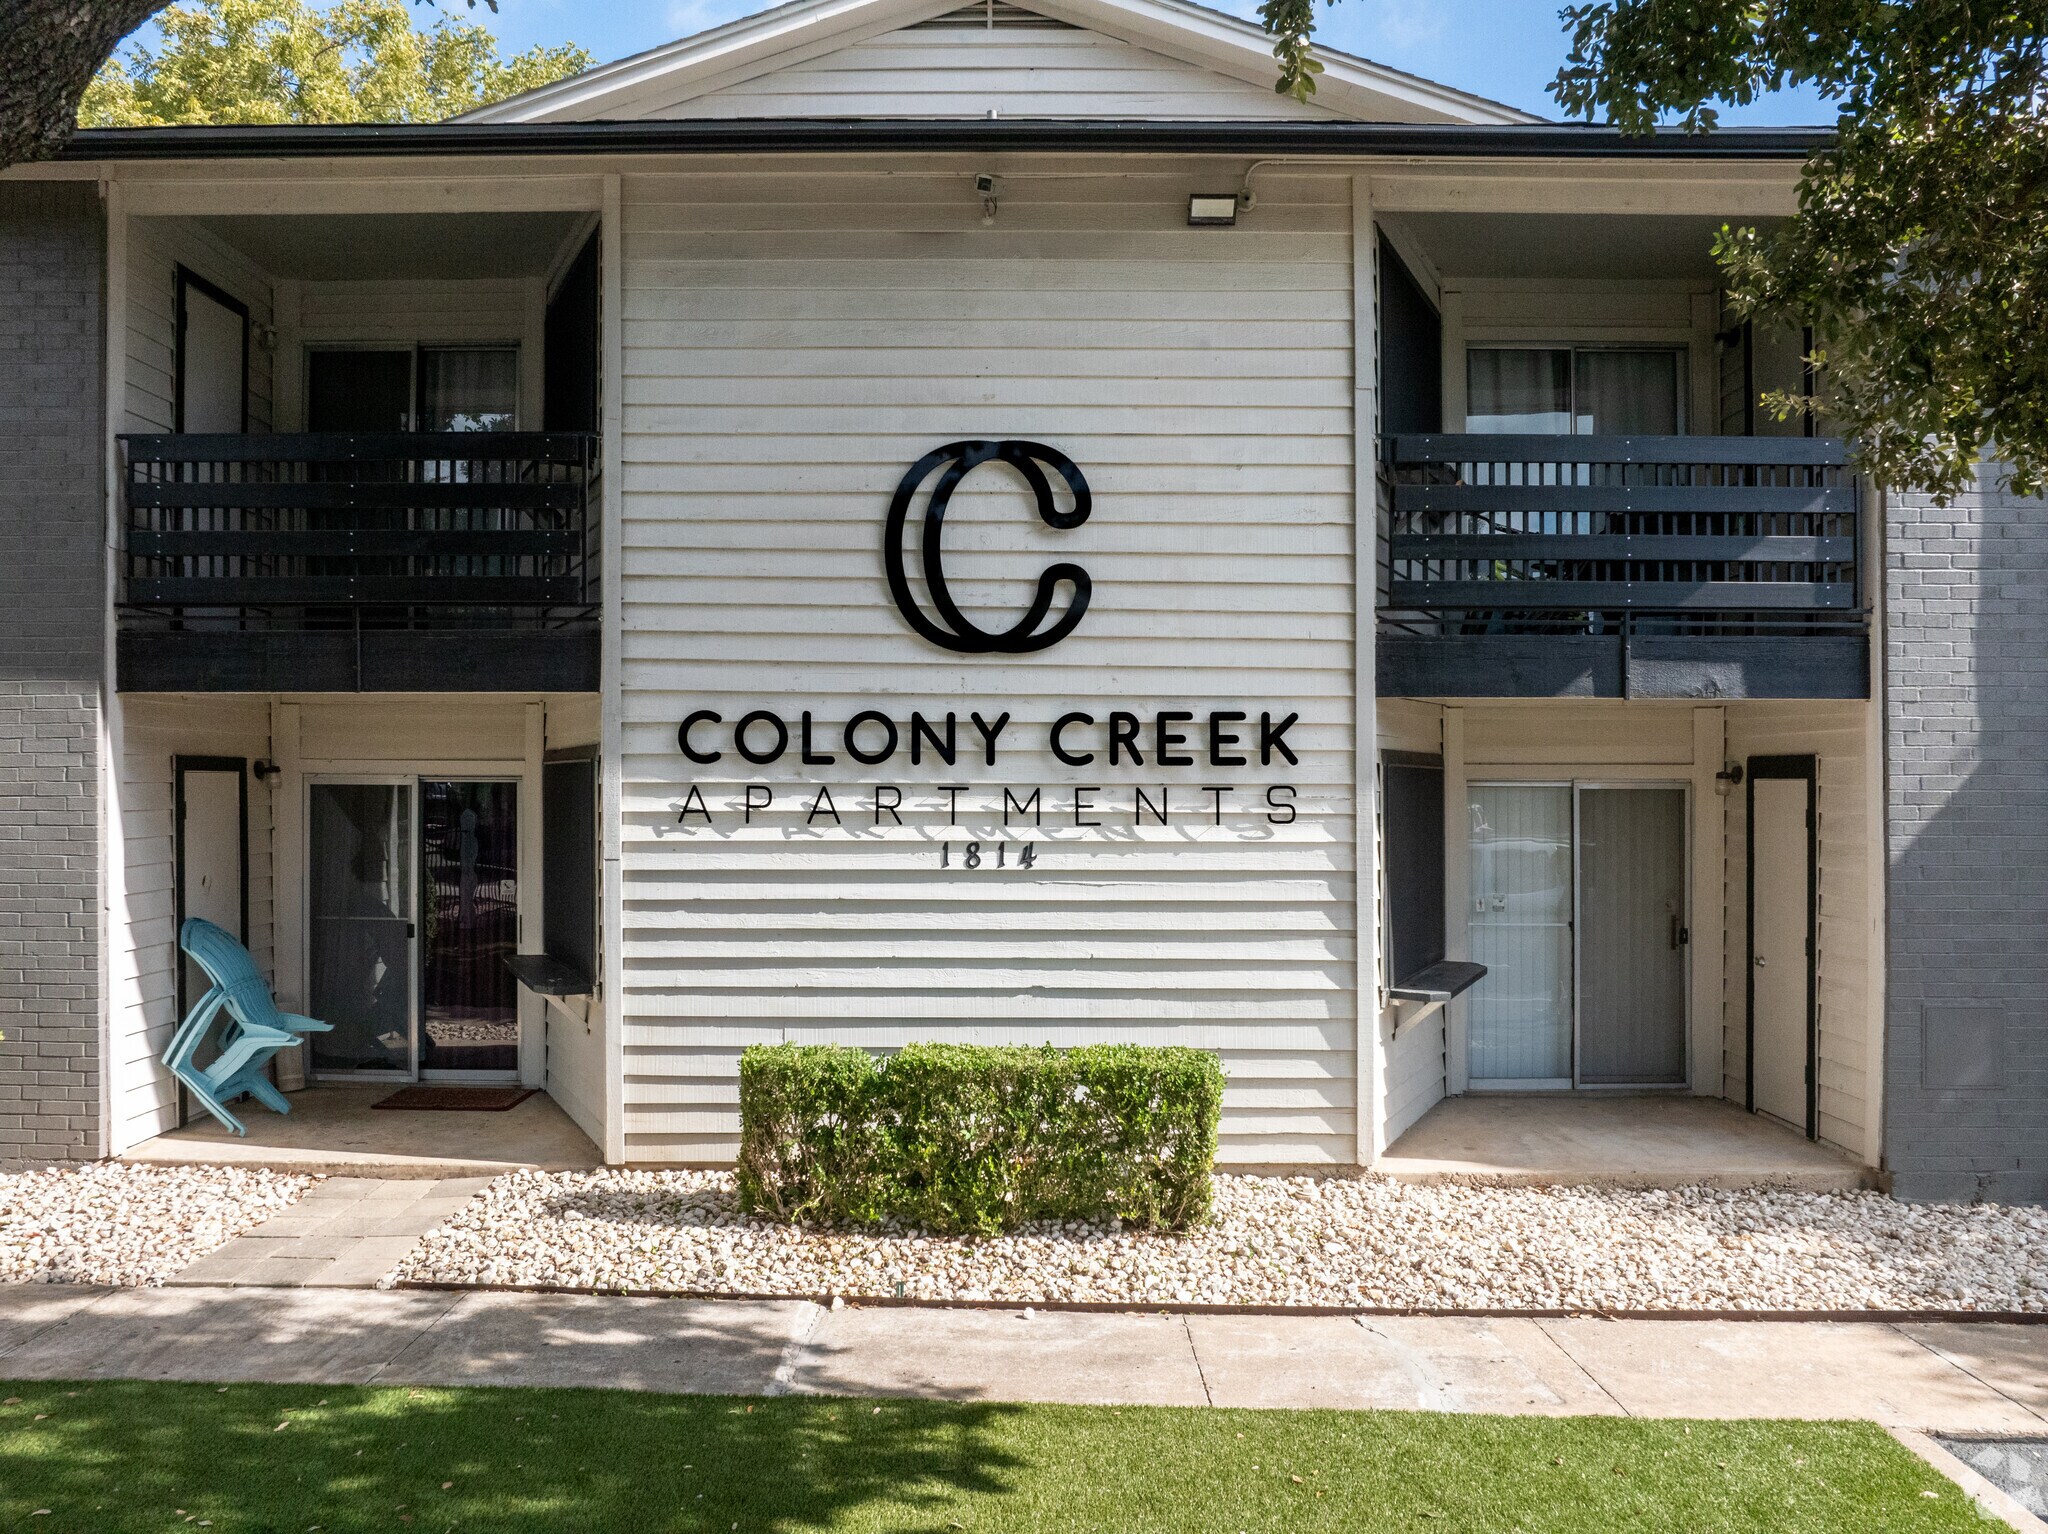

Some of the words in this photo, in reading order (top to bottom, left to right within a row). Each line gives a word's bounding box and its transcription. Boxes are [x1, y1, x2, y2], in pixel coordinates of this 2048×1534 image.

[884, 440, 1093, 654] C
[677, 709, 1011, 767] COLONY
[1049, 711, 1299, 767] CREEK
[677, 783, 1298, 828] APARTMENTS
[941, 840, 1038, 870] 1814
